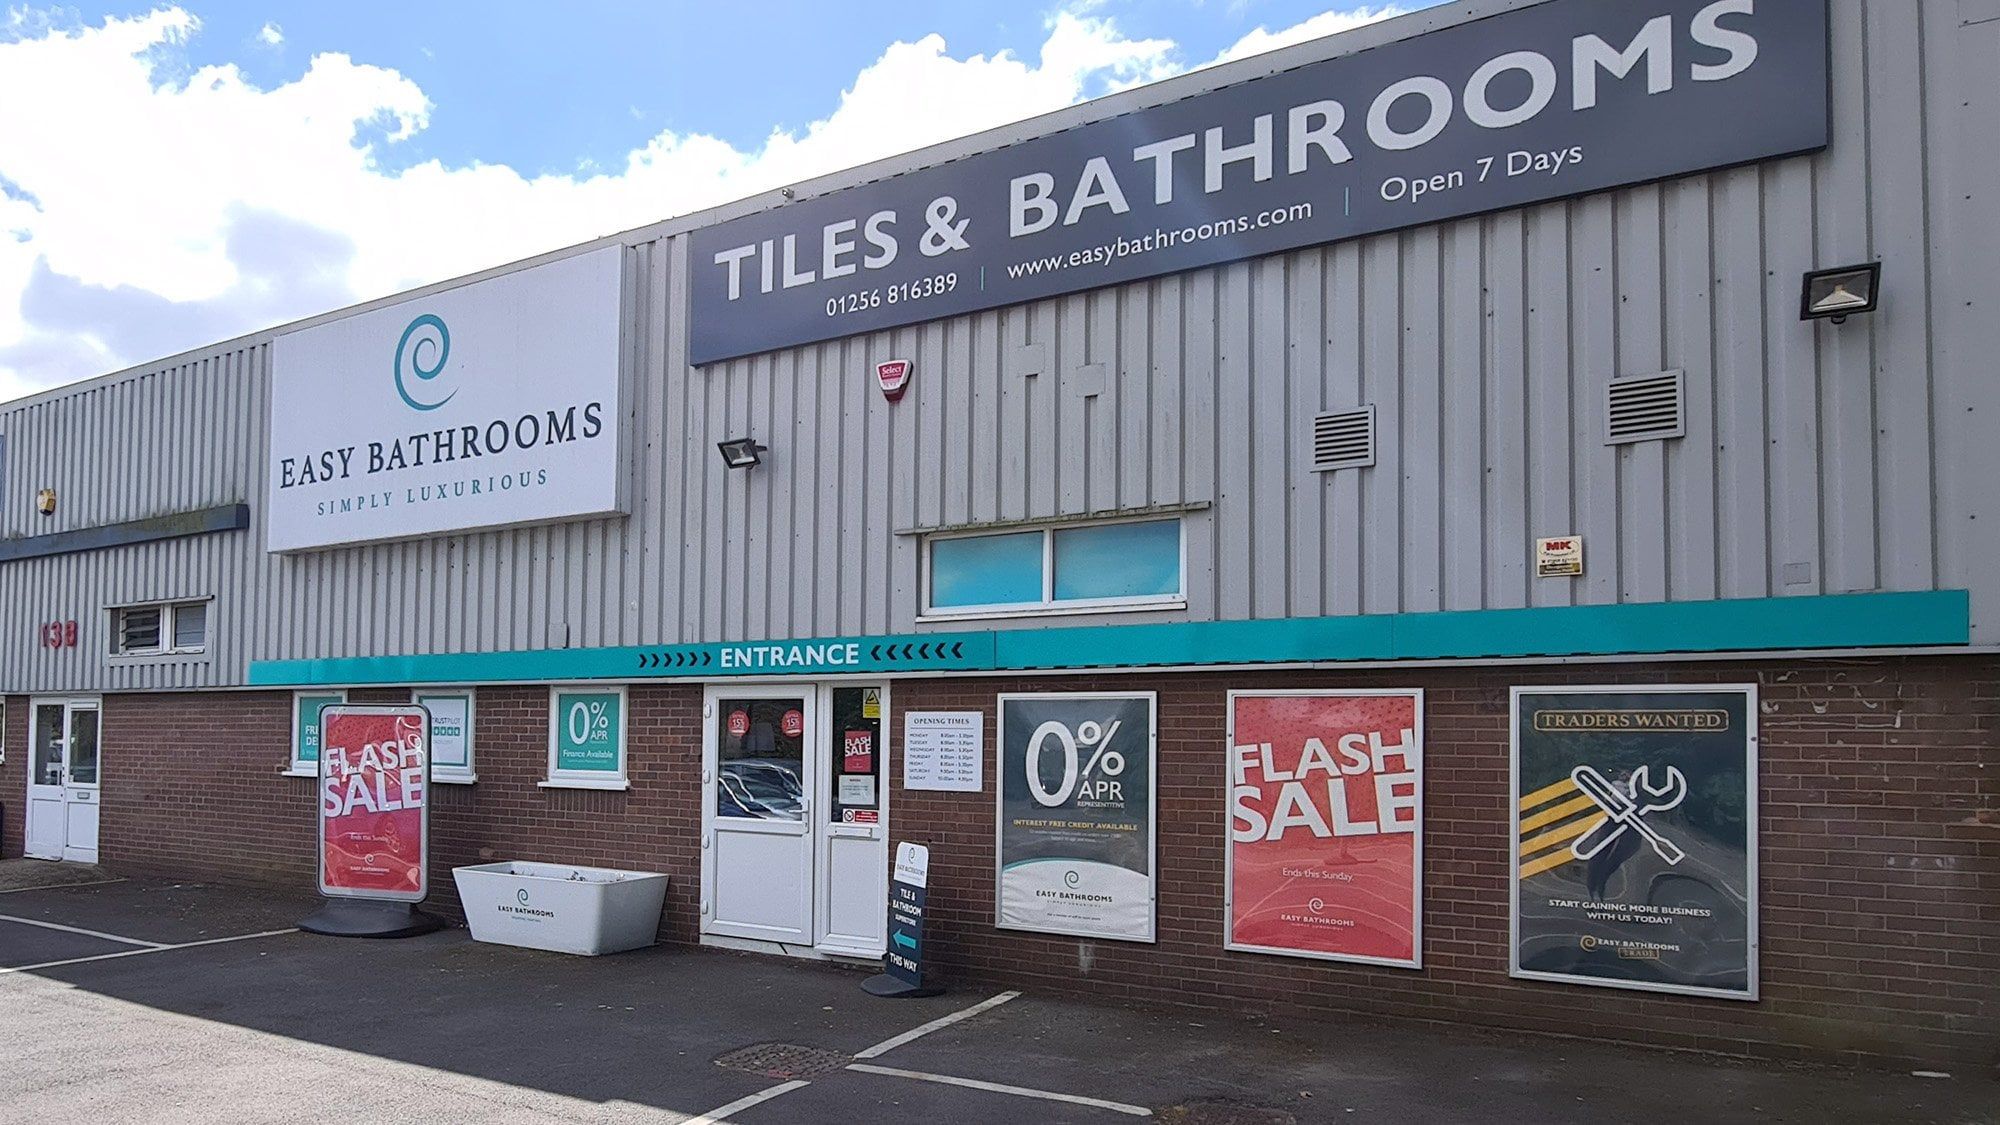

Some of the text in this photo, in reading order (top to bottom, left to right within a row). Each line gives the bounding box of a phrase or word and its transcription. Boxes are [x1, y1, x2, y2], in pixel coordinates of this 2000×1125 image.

[714, 0, 1759, 302] TILES & BATHROOMS
[1380, 146, 1584, 203] Open 7 Days
[1006, 201, 1313, 280] www.easybathrooms.com
[825, 272, 958, 317] 01256 816389
[279, 402, 603, 489] EASY BATHROOMS
[316, 468, 548, 517] SIMPLY LUXURIOUS
[719, 643, 860, 668] ENTRANCE
[569, 701, 608, 745] 0%
[1542, 713, 1722, 728] TRADERS WANTED
[590, 730, 608, 740] APR
[845, 735, 871, 748] FLASH
[325, 738, 423, 777] FLASH
[562, 749, 613, 759] Finance Available
[845, 744, 871, 758] SALE
[1233, 728, 1416, 785] FLASH
[1025, 720, 1126, 808] 0%
[324, 768, 423, 819] SALE
[1076, 780, 1125, 801] APR
[1232, 771, 1416, 843] SALE
[1013, 819, 1138, 832] INTEREST FREE CREDIT AVAILABLE
[1282, 867, 1303, 877] Ends
[1304, 868, 1320, 879] this
[900, 887, 911, 900] TILE
[1036, 889, 1113, 903] EASY BATHROOMS
[515, 907, 554, 918] BATHROOMS
[892, 899, 922, 917] BATHROOM
[1549, 899, 1711, 918] START GAINING MORE BUSINESS
[1586, 911, 1673, 925] WITH US TODAY!
[1281, 914, 1301, 922] EASY
[1303, 916, 1355, 927] BATHROOMS
[1597, 938, 1680, 952] EASY BATHROOMS
[889, 951, 918, 973] THIS WAY
